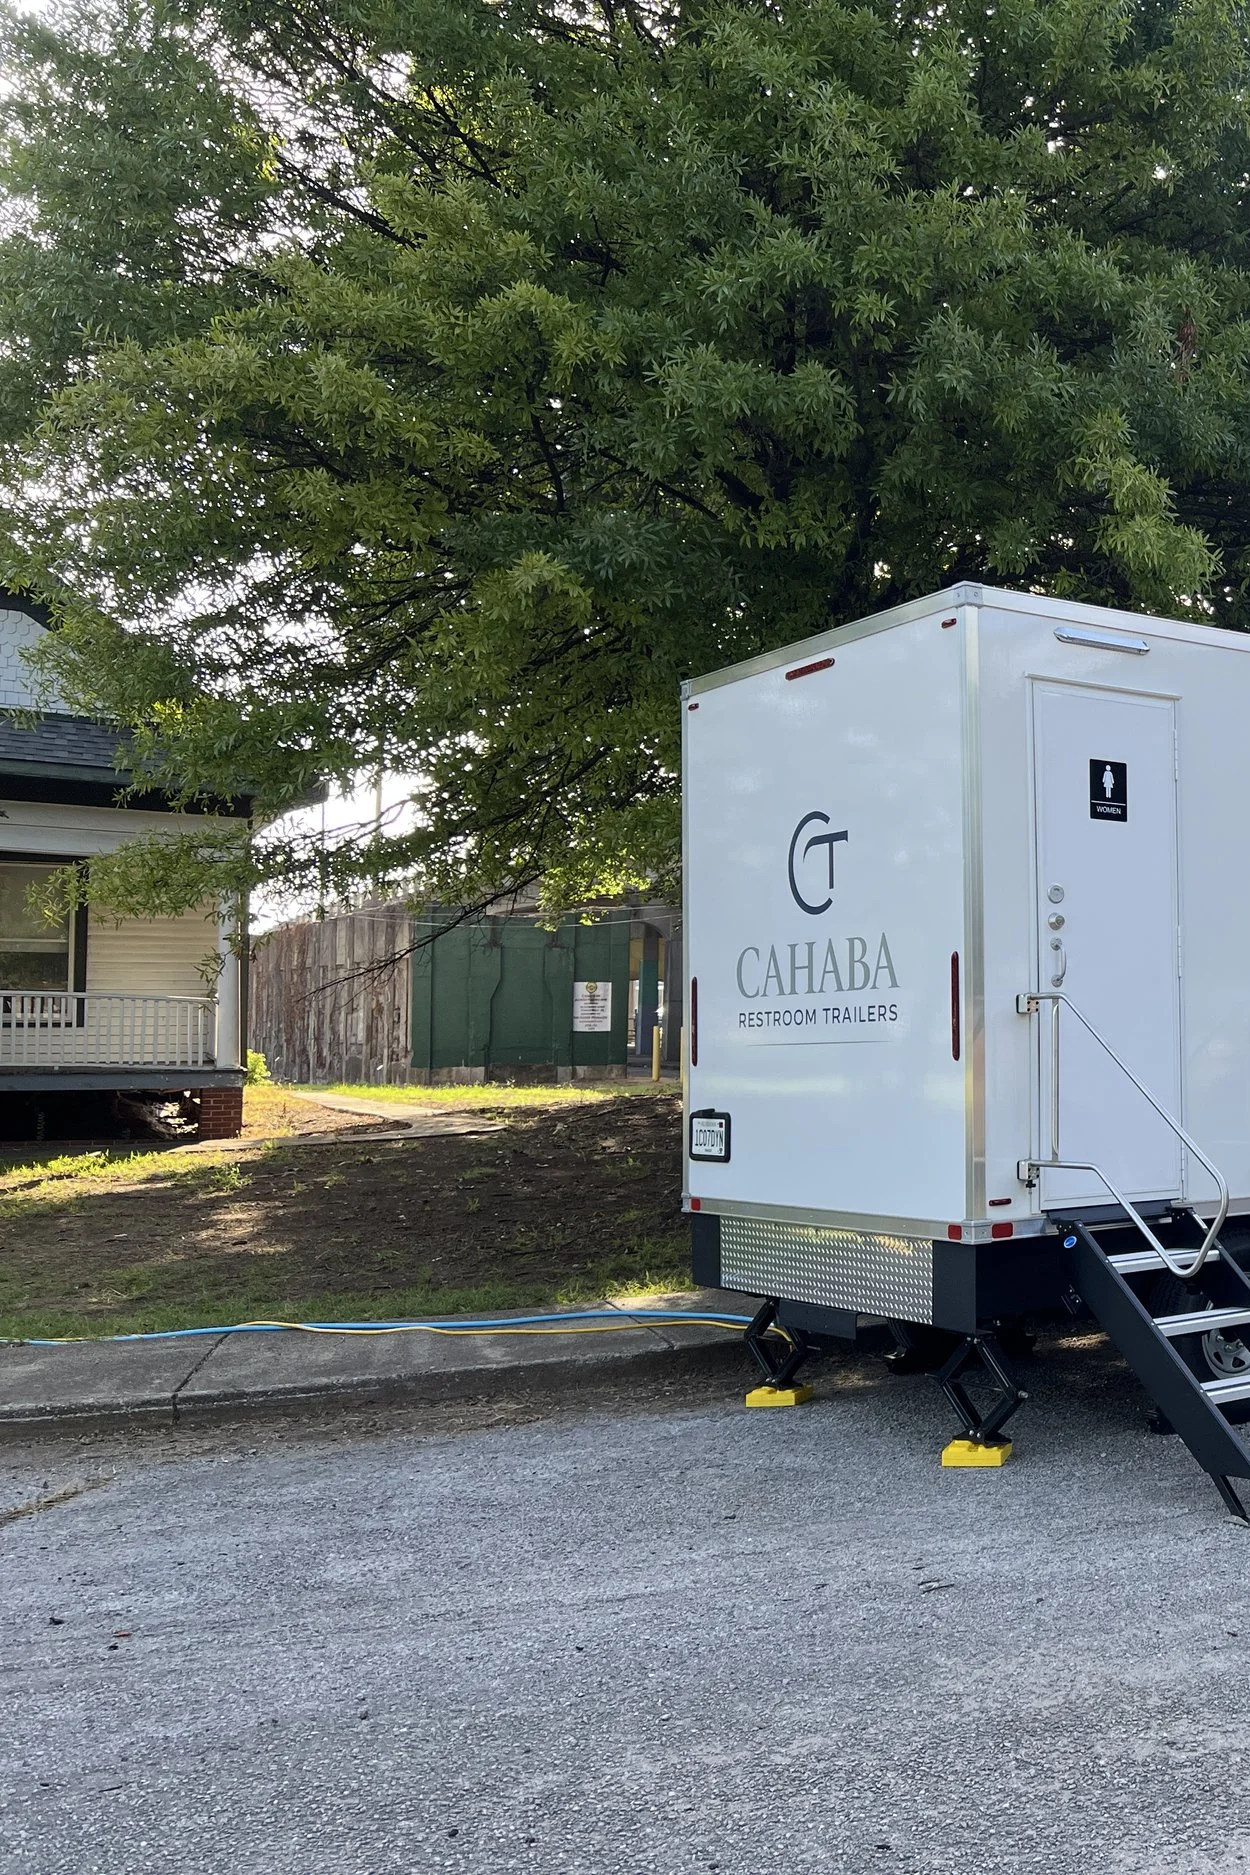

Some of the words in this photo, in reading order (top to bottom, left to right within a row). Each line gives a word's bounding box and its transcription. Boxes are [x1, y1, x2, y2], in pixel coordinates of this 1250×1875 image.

[1096, 805, 1121, 815] WOMEN
[736, 931, 901, 999] CAHABA
[738, 1008, 817, 1028] RESTROOM
[822, 1003, 898, 1025] TRAILERS
